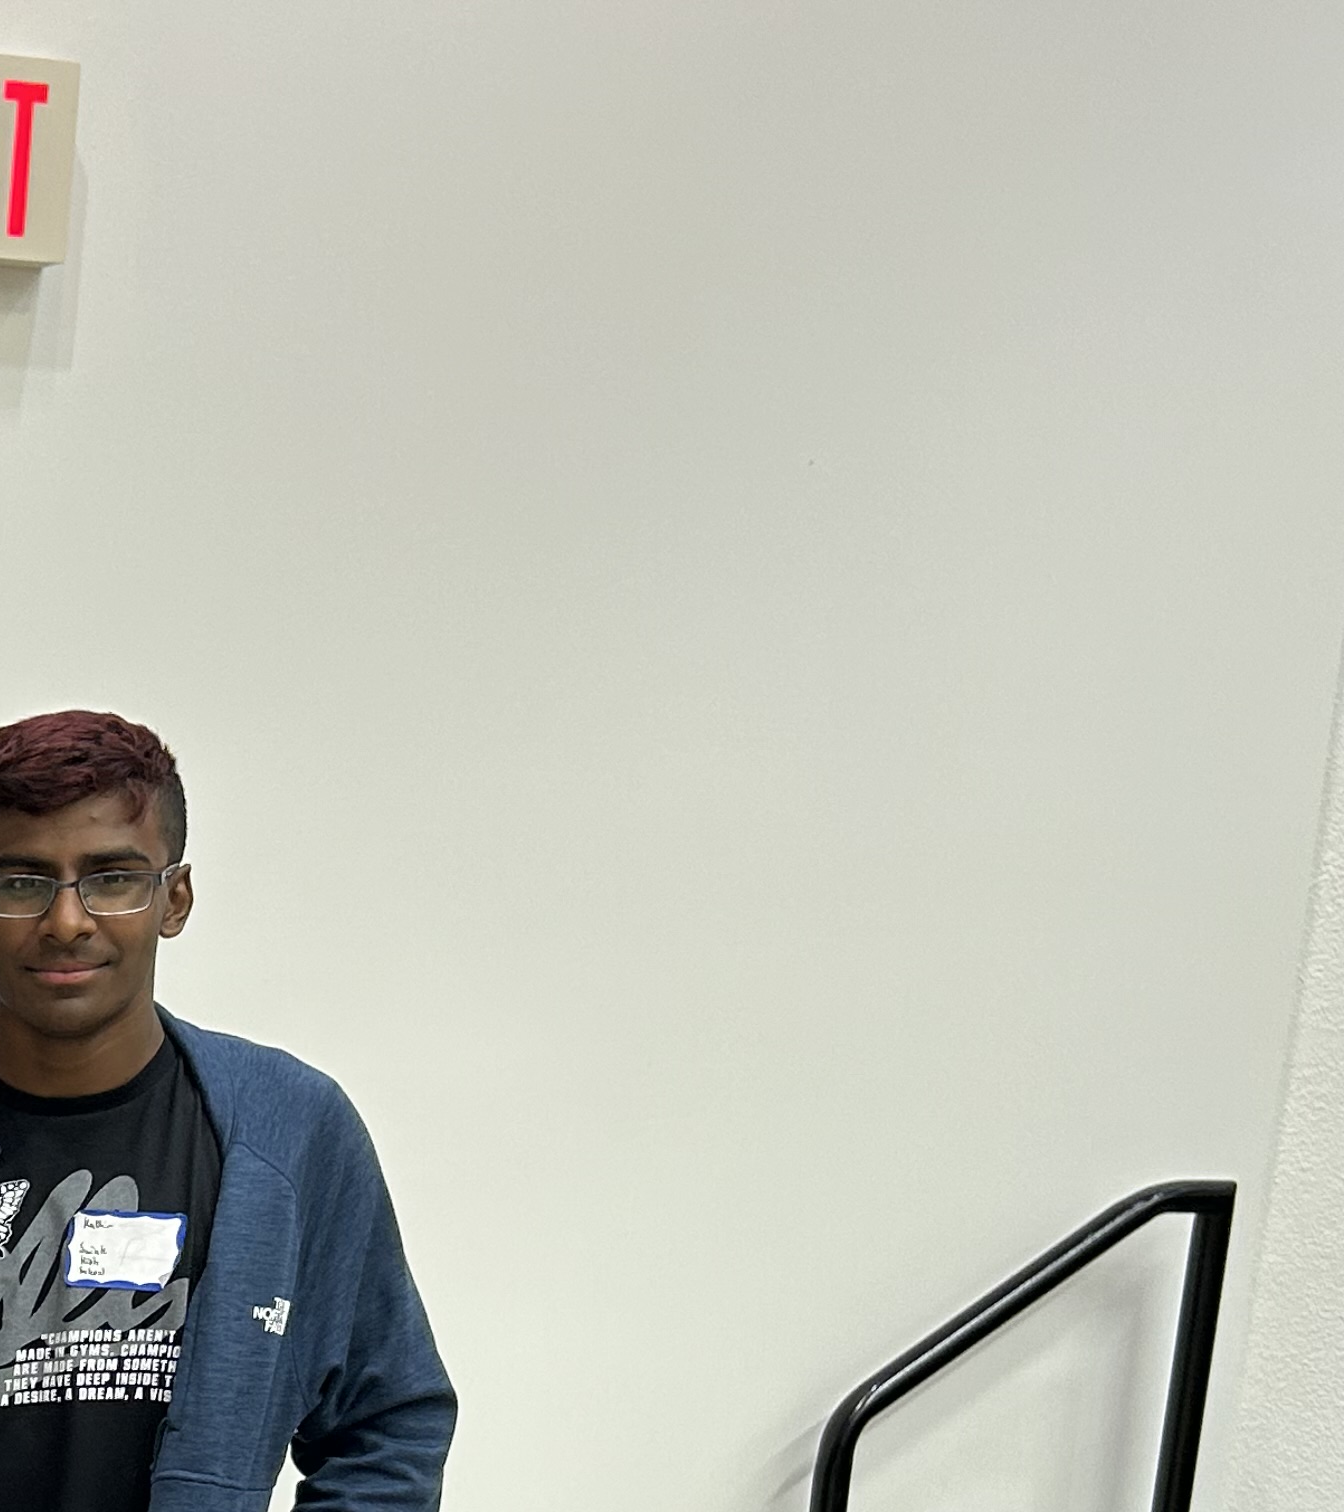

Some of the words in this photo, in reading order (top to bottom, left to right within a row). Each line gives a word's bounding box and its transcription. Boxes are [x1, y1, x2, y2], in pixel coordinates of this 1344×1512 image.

[127, 1329, 176, 1342] AREN'T
[15, 1348, 52, 1362] MADE
[69, 1344, 115, 1357] GYMS.
[121, 1344, 182, 1358] CHAMPIO
[13, 1362, 39, 1377] ARE
[43, 1359, 74, 1374] MADE
[78, 1358, 118, 1372] FROM
[123, 1358, 178, 1373] SOMETH
[4, 1377, 38, 1391] THEY
[42, 1374, 71, 1388] HAVE
[76, 1373, 110, 1386] DEEP
[115, 1372, 159, 1386] INSIDE
[0, 1394, 9, 1407] A
[14, 1389, 62, 1405] DESIRE,
[64, 1387, 73, 1400] A
[78, 1387, 129, 1400] DREAM,
[134, 1388, 144, 1400] A
[150, 1388, 173, 1403] VIS
